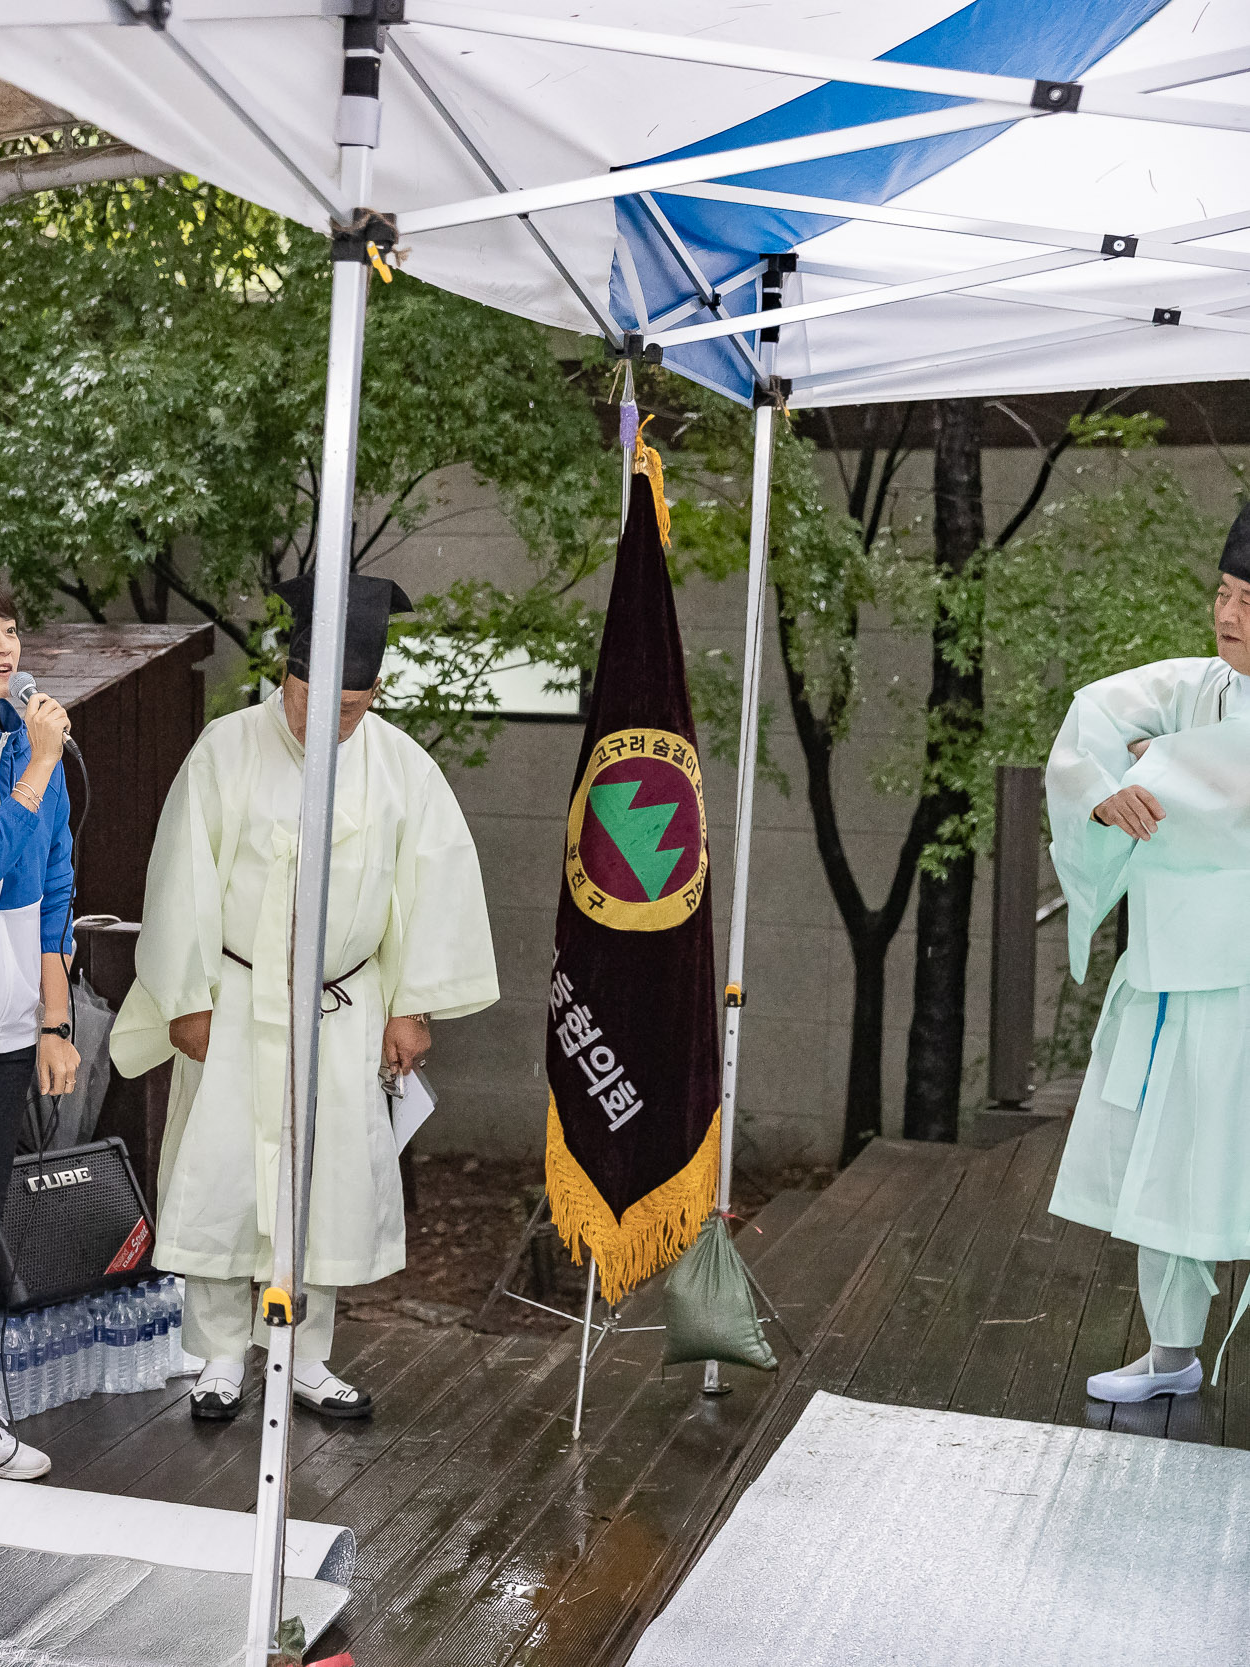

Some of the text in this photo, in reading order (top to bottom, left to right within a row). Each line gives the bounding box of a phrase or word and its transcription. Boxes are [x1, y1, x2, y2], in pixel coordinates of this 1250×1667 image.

[594, 735, 697, 777] 고구려 숨결이
[27, 1167, 92, 1193] CUBE
